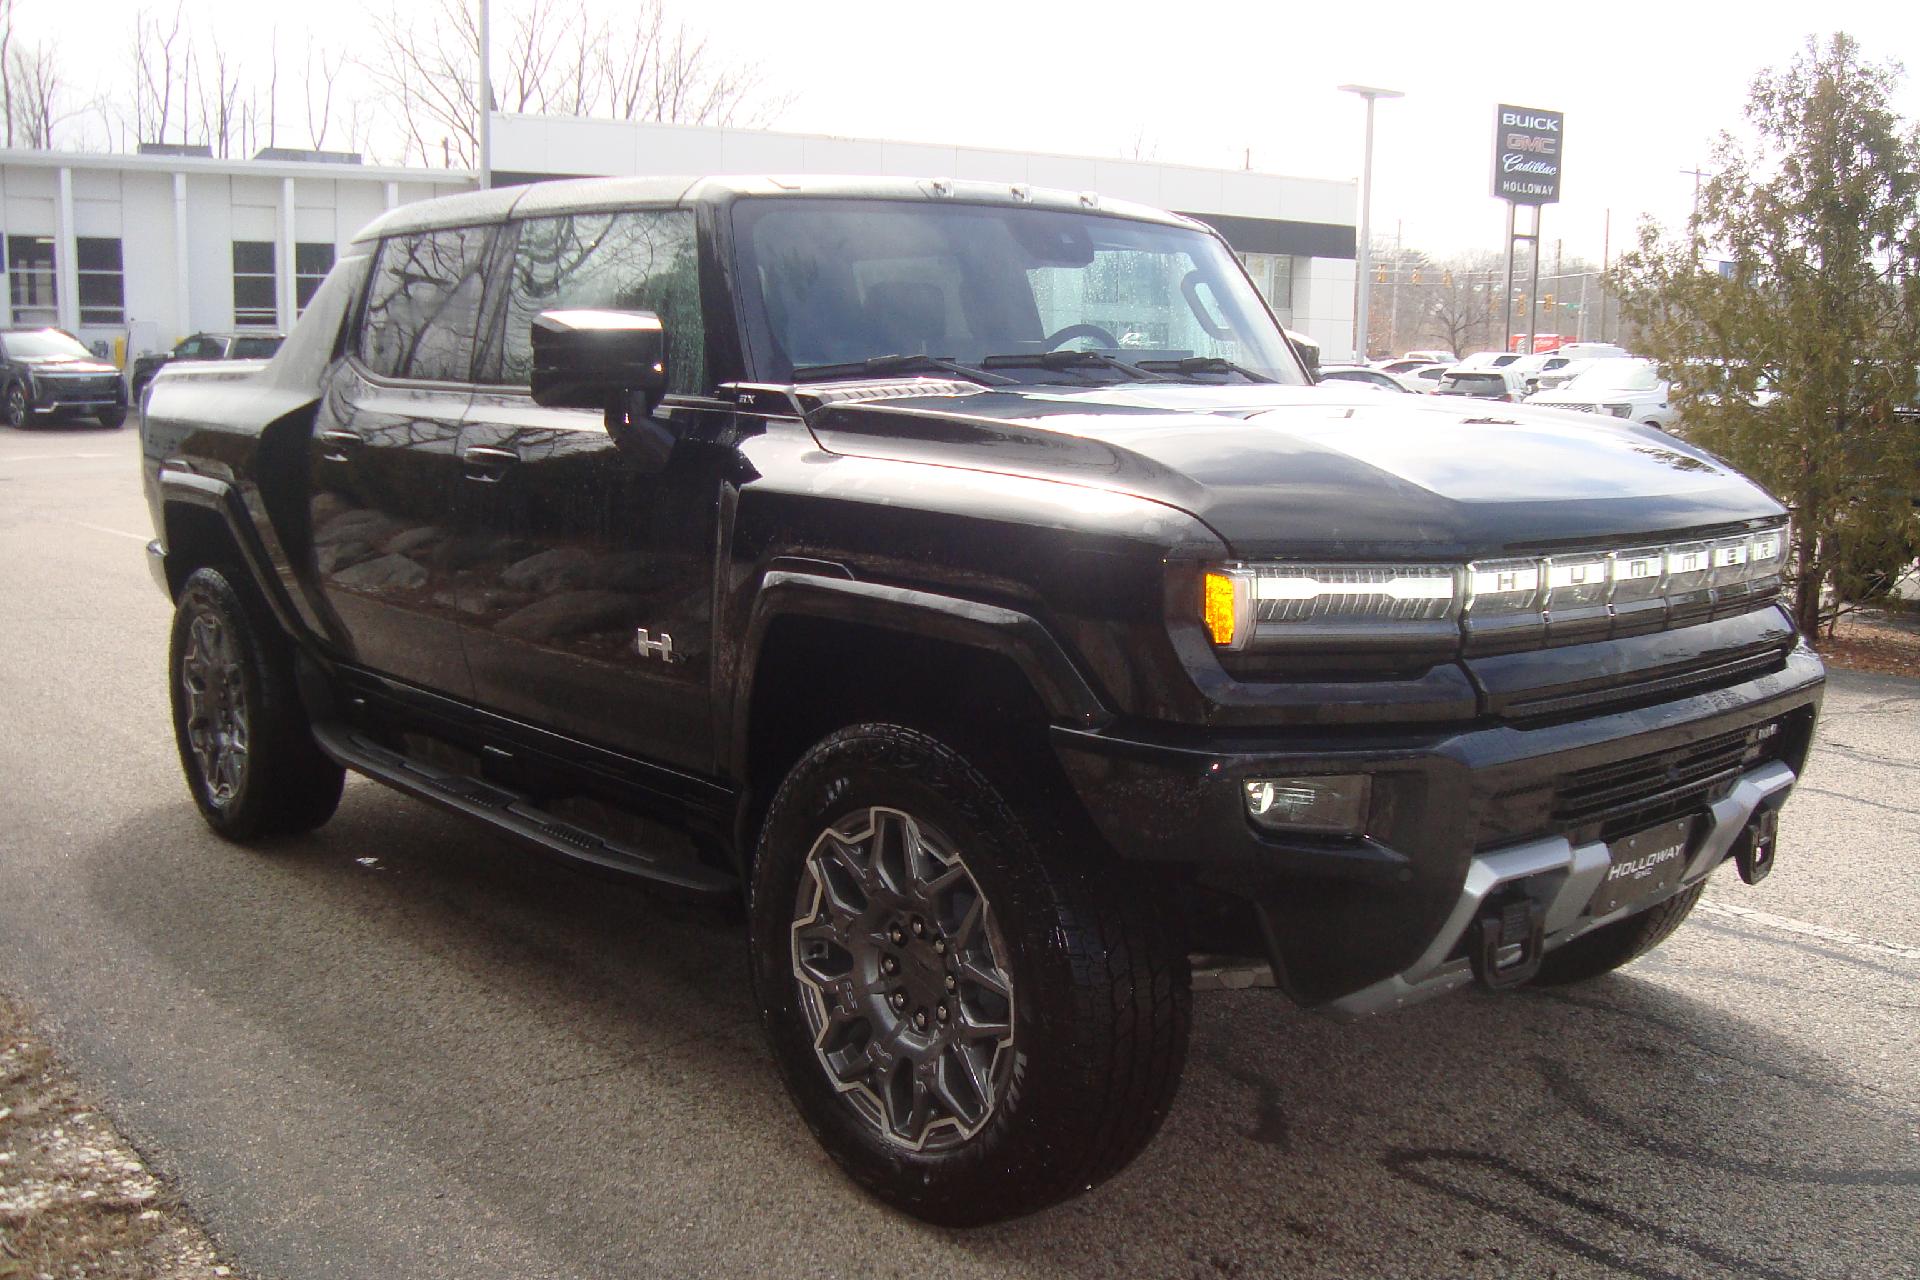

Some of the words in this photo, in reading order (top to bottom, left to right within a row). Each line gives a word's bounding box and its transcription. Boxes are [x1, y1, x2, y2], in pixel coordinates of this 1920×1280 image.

[1502, 113, 1559, 132] BUICK
[1506, 133, 1556, 154] GMC
[1502, 153, 1557, 176] Cadillac
[1503, 180, 1554, 195] HOLLOWAY
[1607, 842, 1685, 881] HOLLOWAY
